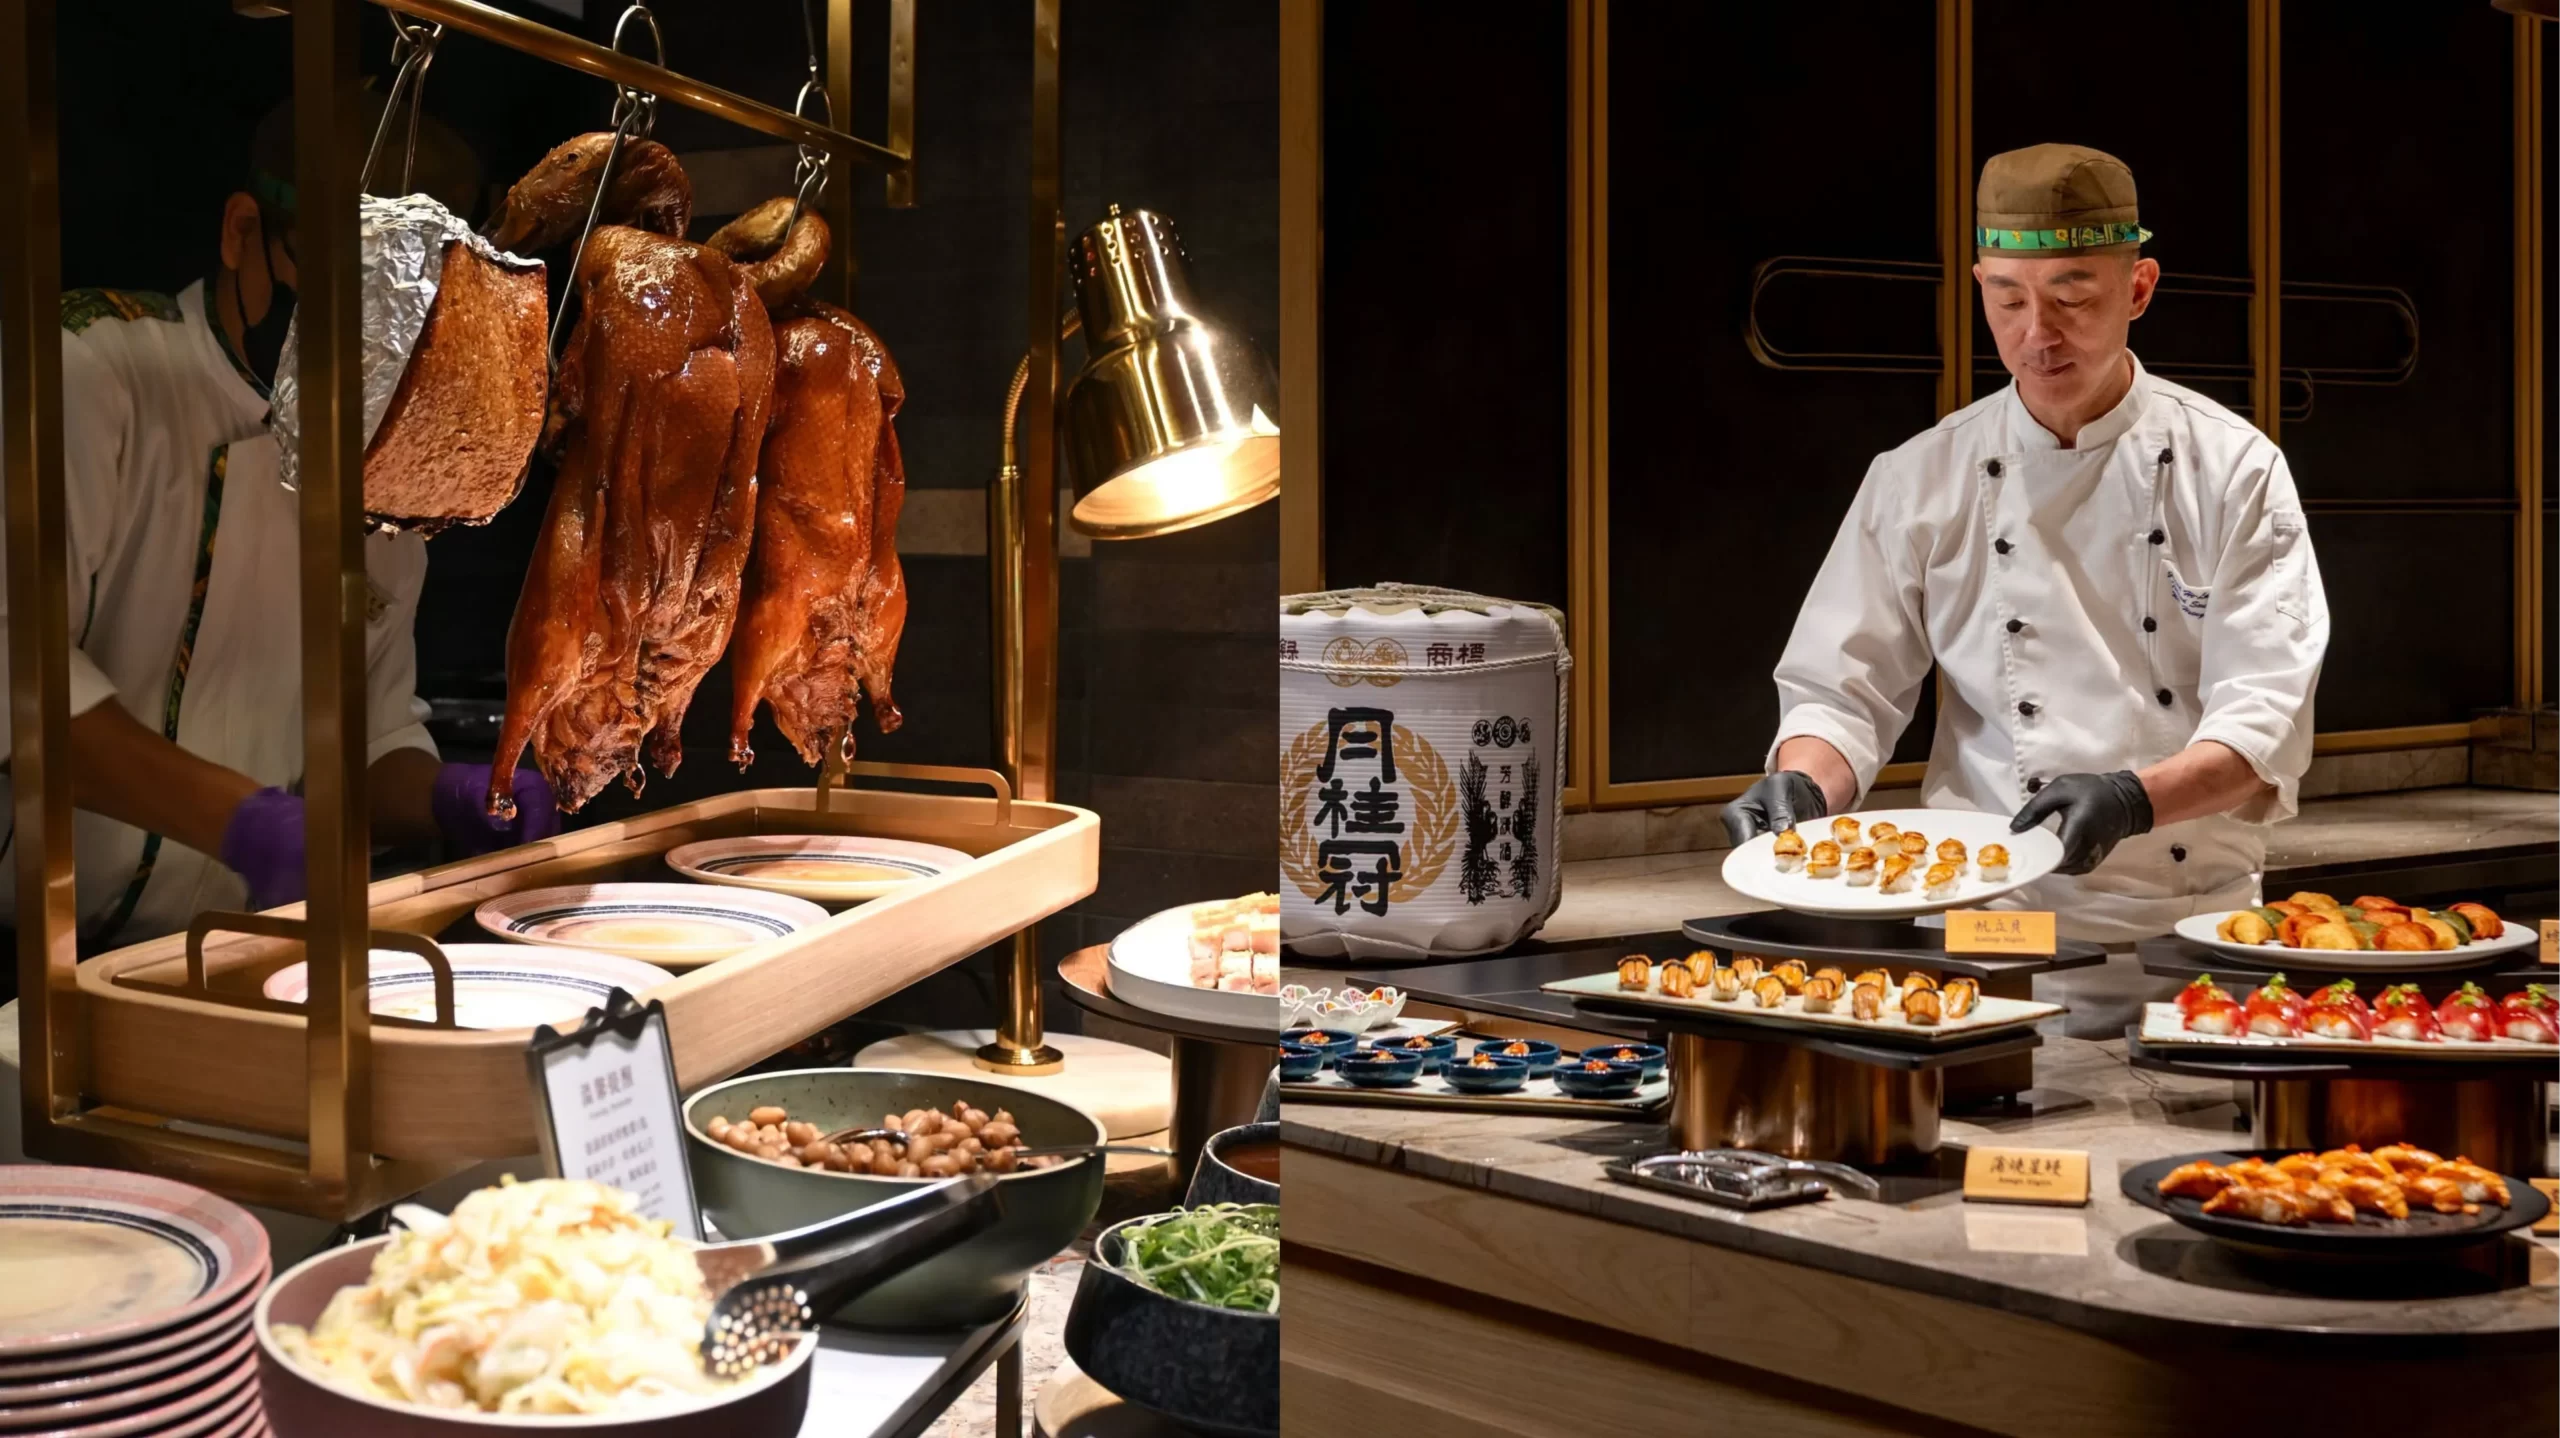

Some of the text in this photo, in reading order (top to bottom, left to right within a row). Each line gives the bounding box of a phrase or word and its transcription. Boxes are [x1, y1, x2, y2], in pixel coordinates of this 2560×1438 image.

[1426, 642, 1485, 666] 商標
[1313, 706, 1405, 917] 月桂冠
